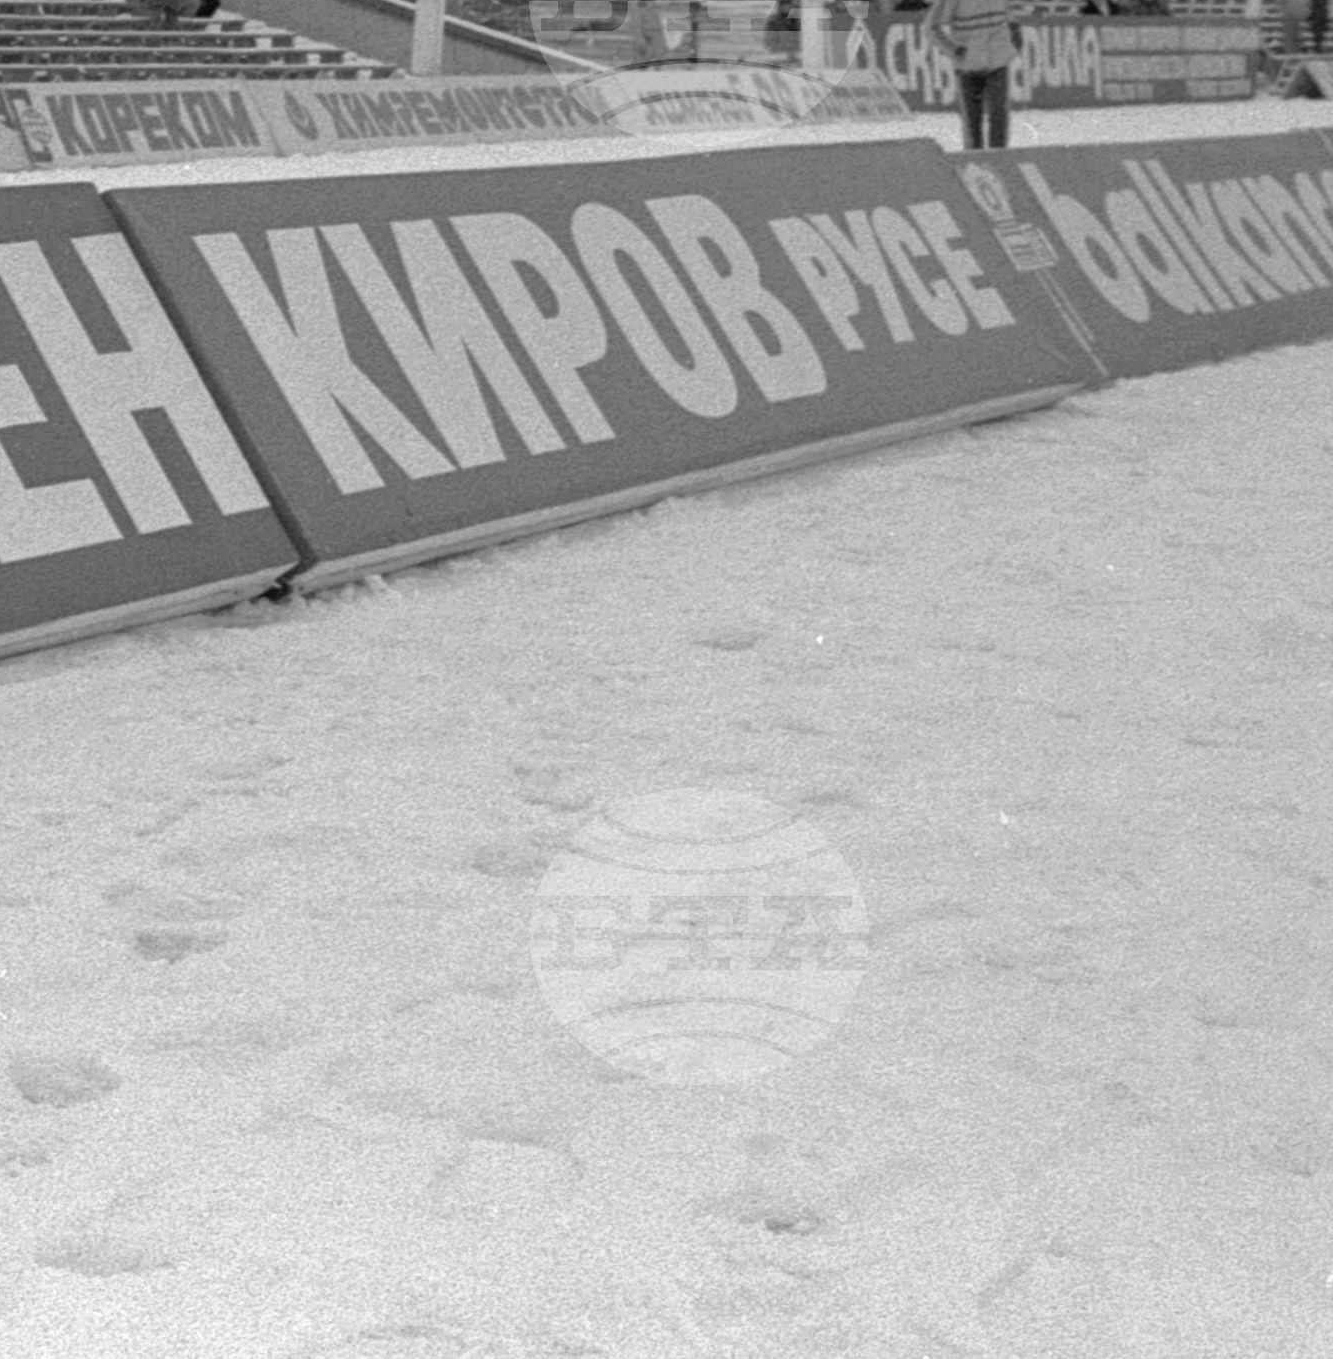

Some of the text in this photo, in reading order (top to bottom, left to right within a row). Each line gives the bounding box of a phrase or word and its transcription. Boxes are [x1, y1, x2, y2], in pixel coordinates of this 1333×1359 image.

[45, 90, 262, 157] КОРЕКОМ
[192, 193, 828, 495] КИРОВ
[769, 200, 1017, 351] РУСЕ
